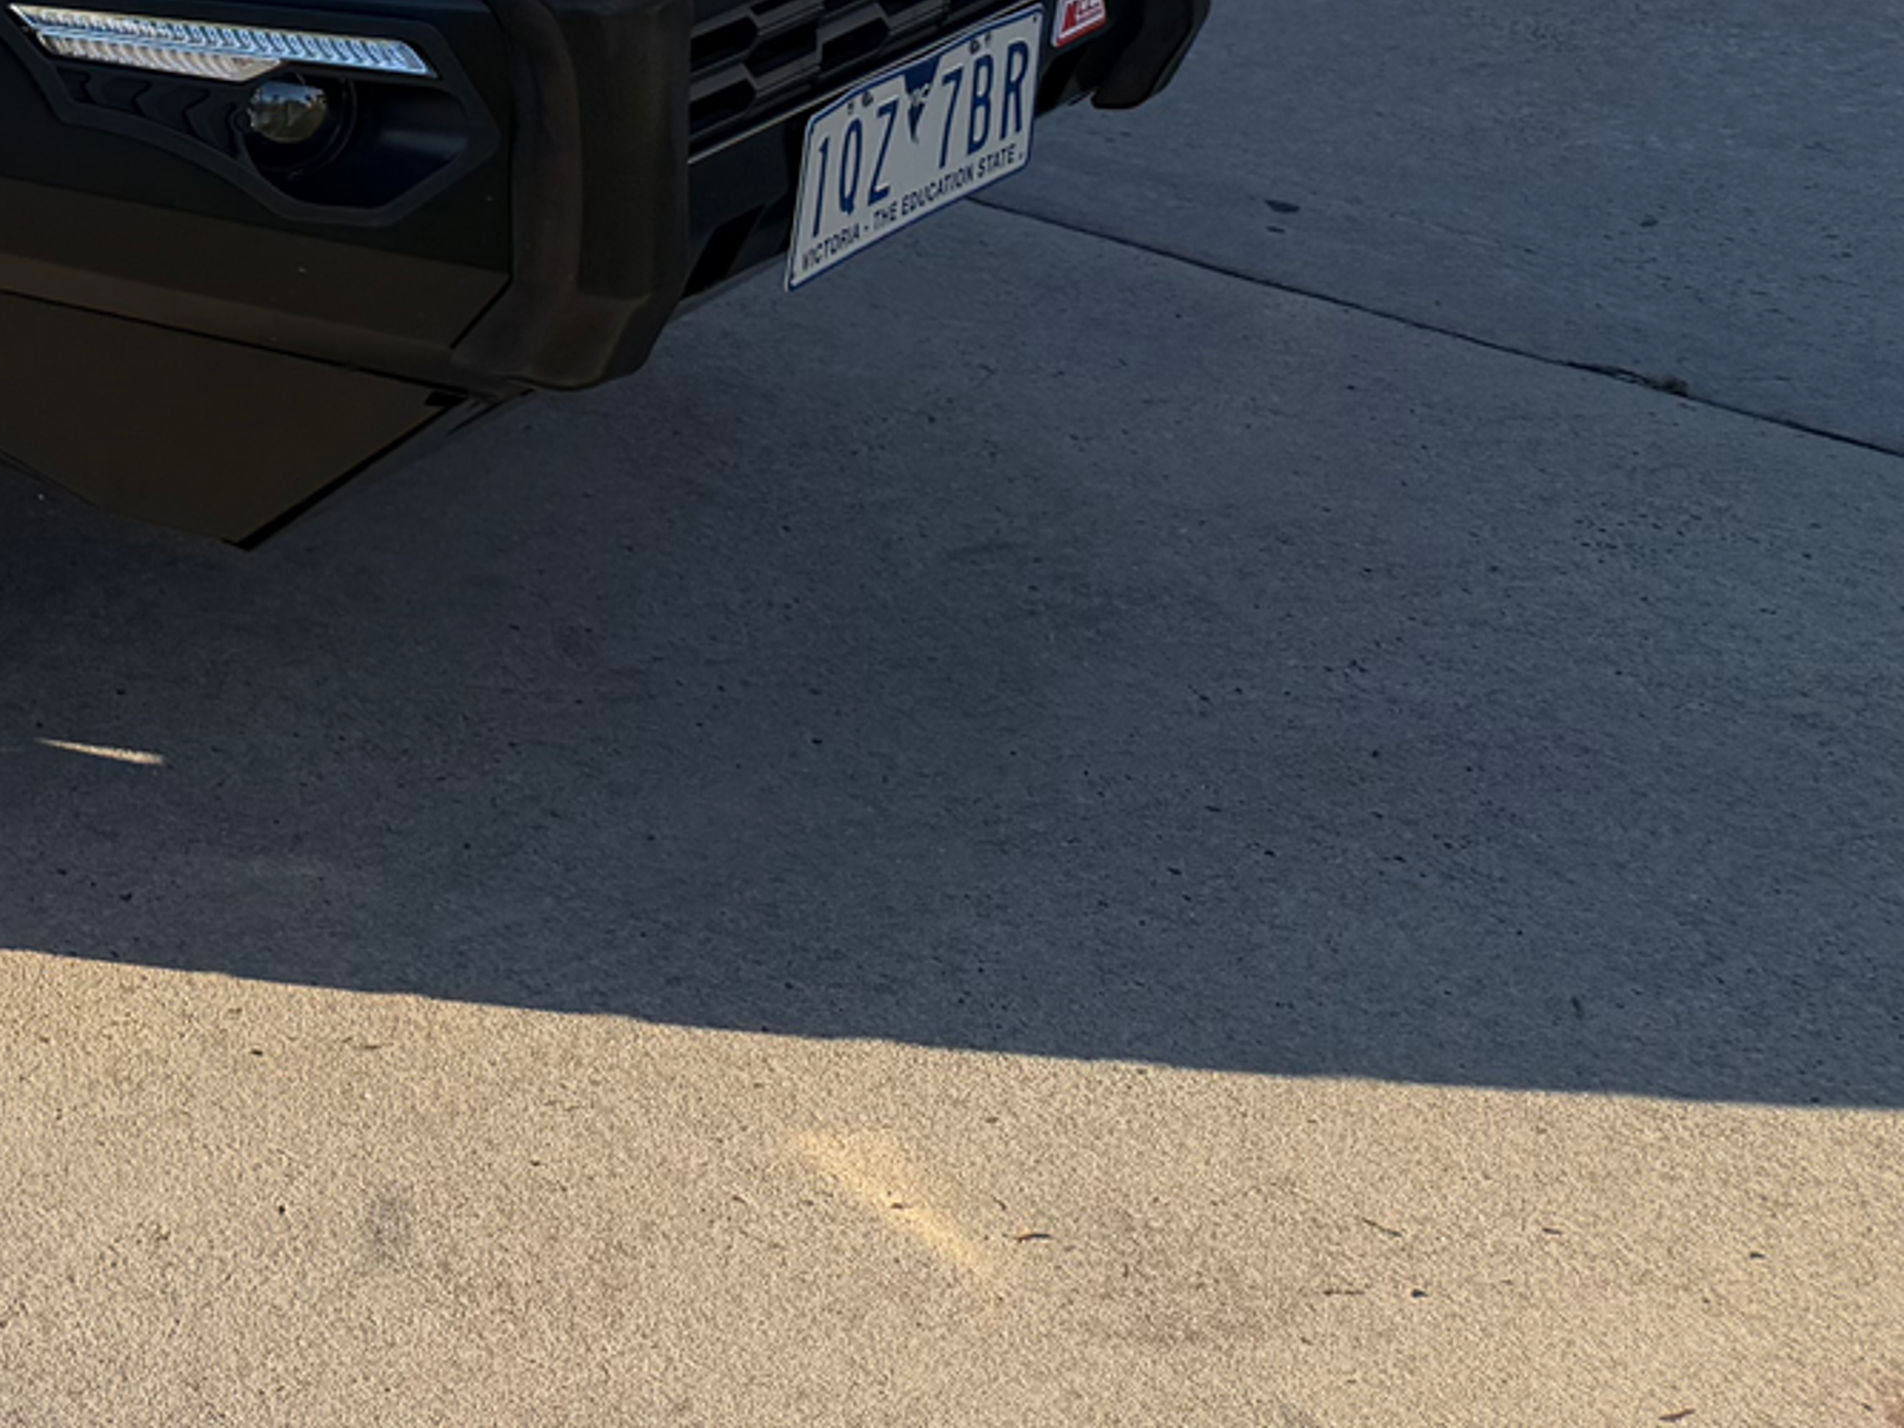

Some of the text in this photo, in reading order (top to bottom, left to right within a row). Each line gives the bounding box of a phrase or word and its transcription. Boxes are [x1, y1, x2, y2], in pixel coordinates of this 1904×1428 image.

[801, 223, 861, 272] VICTORIA
[872, 202, 898, 231] THE
[900, 170, 975, 217] EDUCATION
[977, 145, 1016, 173] STATE
[812, 39, 1030, 239] 1QZ 7BR
